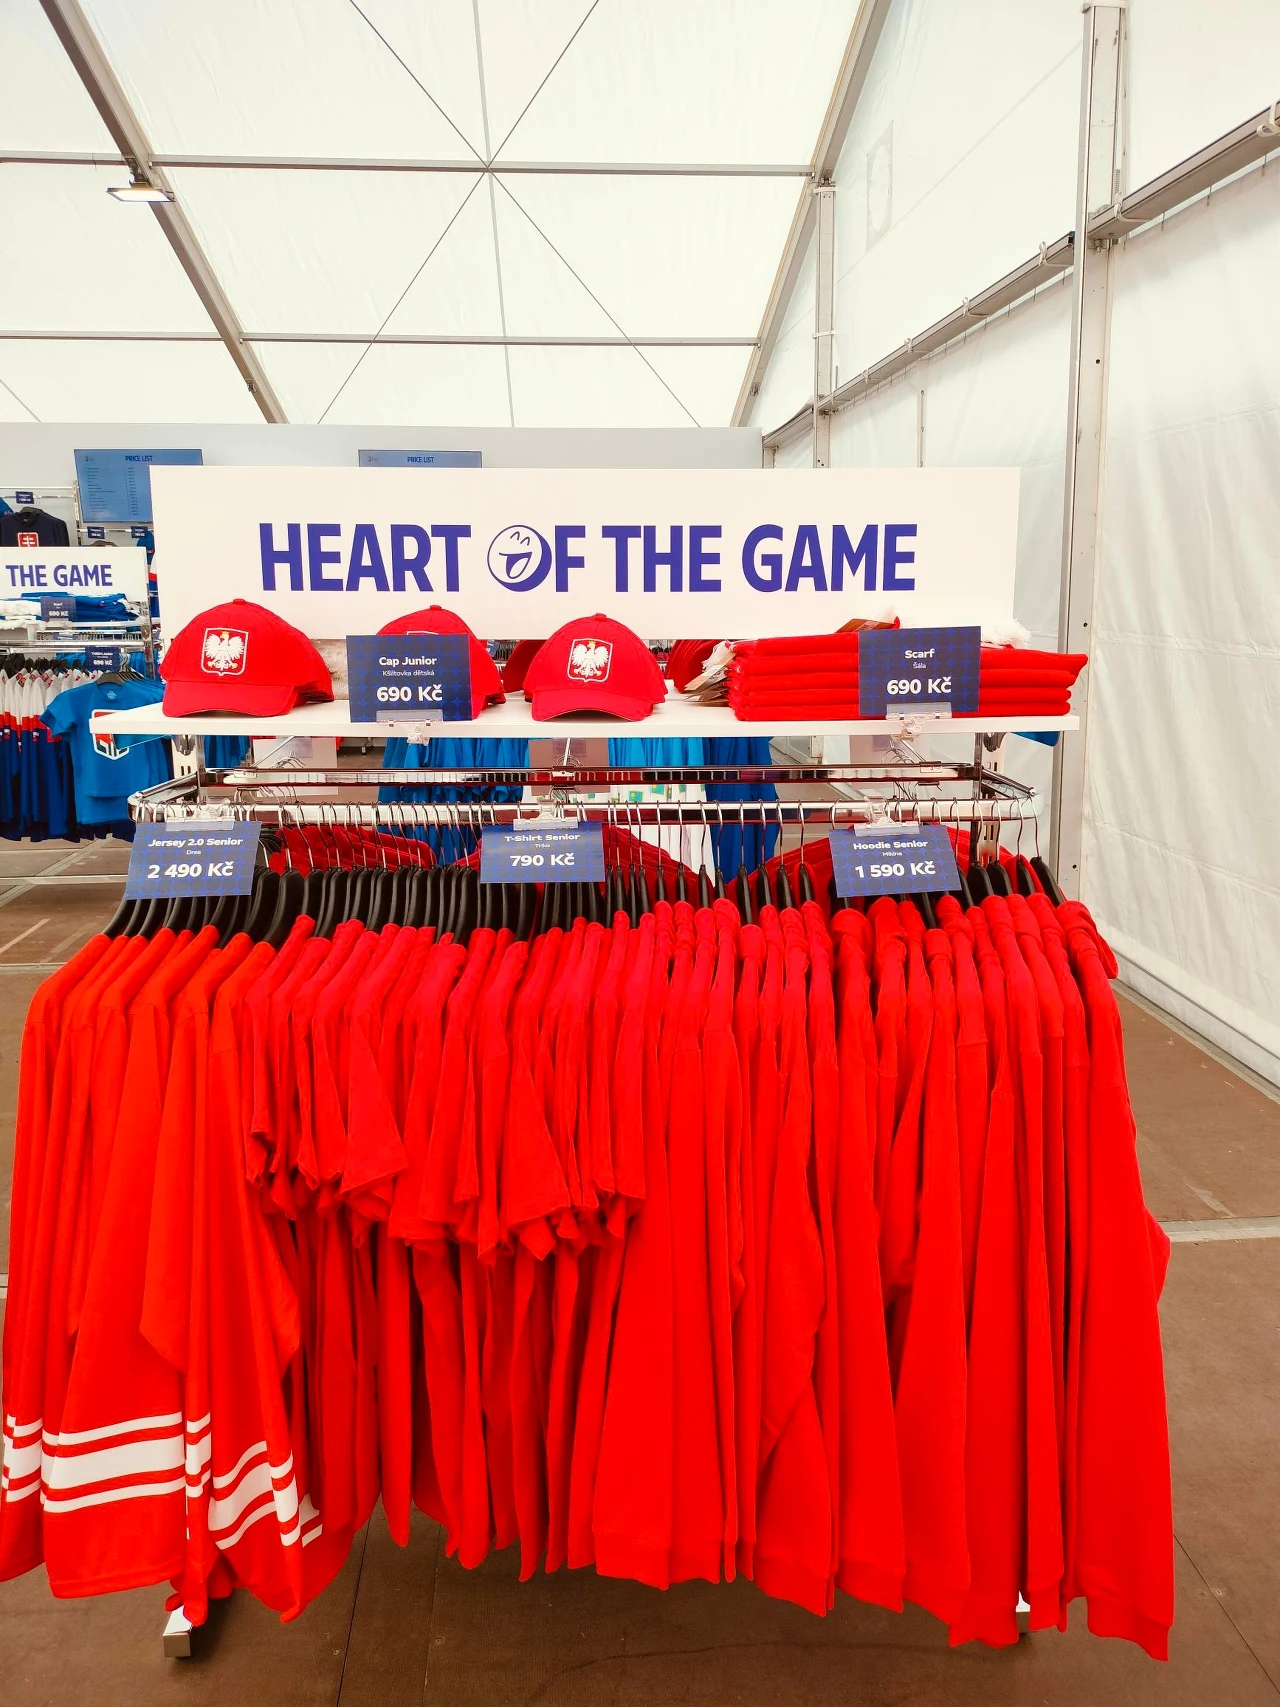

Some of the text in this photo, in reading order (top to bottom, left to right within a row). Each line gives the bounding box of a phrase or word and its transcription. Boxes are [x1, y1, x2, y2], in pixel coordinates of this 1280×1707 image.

[259, 523, 471, 592] HEART
[602, 525, 722, 592] THE
[742, 523, 917, 592] GAME
[5, 565, 113, 586] THE GAME
[379, 656, 438, 667] Cap Junior
[904, 648, 936, 659] Scarf
[376, 684, 443, 702] 690 Kč
[887, 676, 952, 695] 690 Kč
[148, 837, 243, 848] Jersey 2.0 Senior
[504, 833, 581, 842] T-Shirt Senior
[853, 840, 929, 850] Hoodie Senior
[509, 852, 575, 867] 790 Kč
[147, 861, 235, 879] 2 490 Kč
[855, 860, 936, 878] 1 590 Kč
